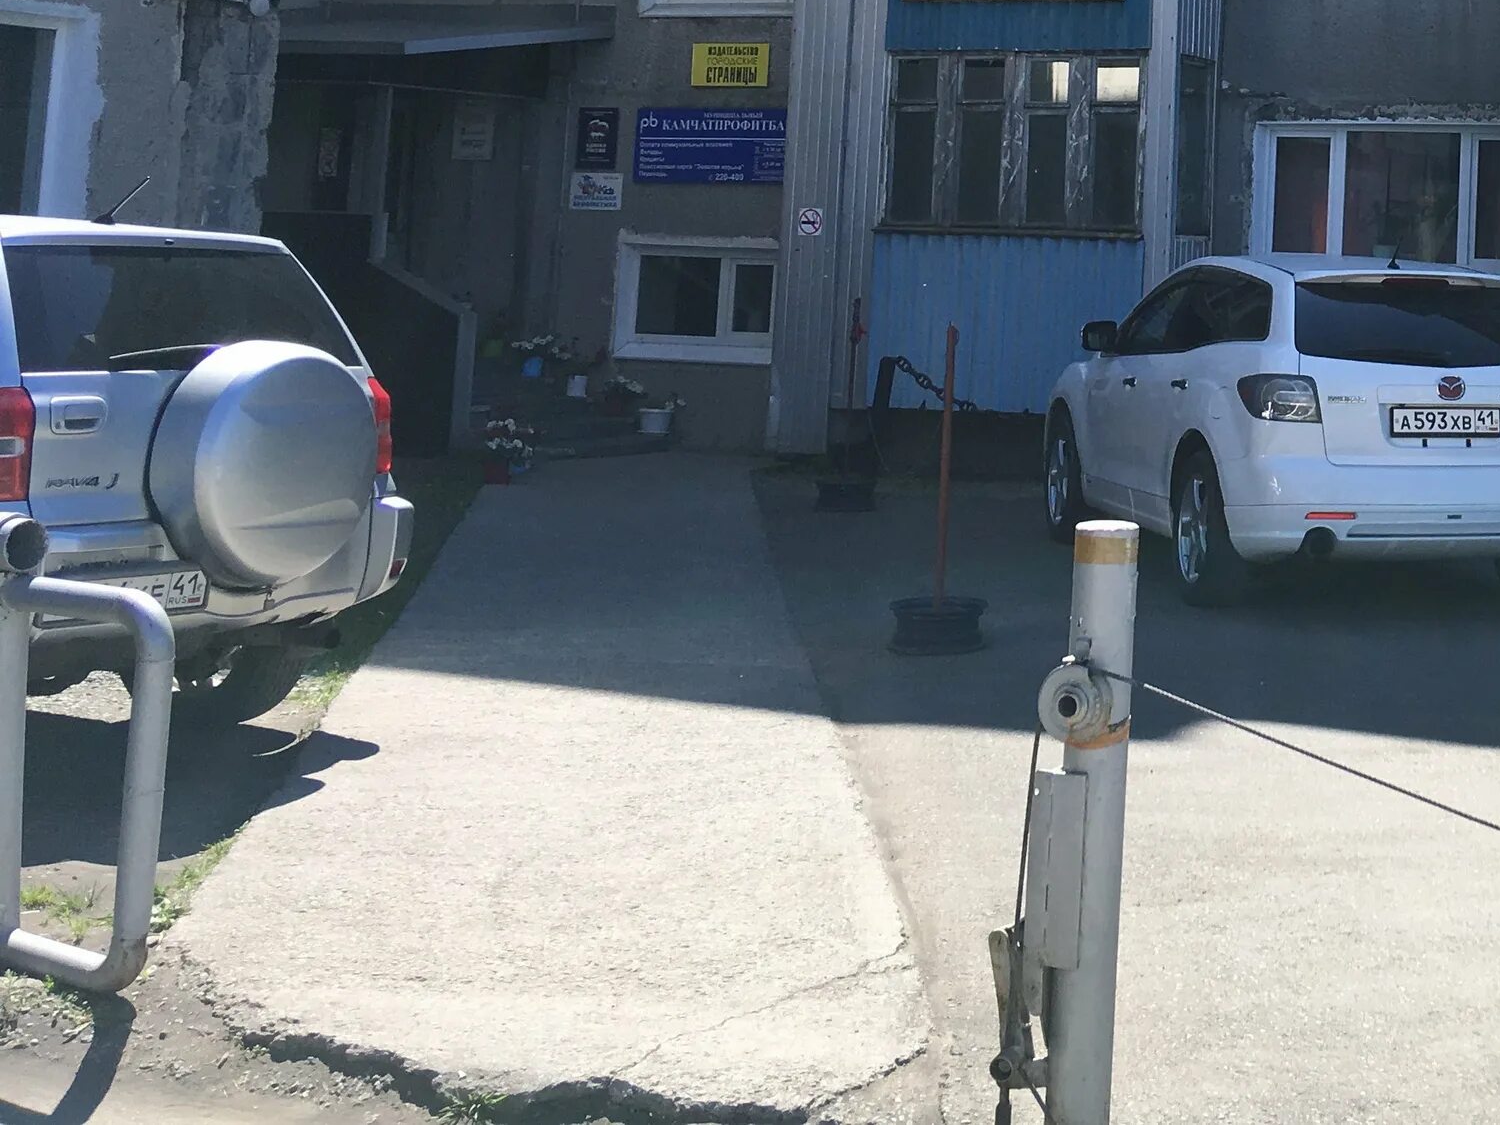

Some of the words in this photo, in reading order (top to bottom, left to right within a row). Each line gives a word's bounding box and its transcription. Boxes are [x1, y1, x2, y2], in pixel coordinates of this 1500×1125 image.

[706, 67, 757, 85] СТРАНИЦЫ
[1477, 411, 1494, 424] 41
[173, 572, 200, 595] 41
[168, 597, 187, 605] RUS
